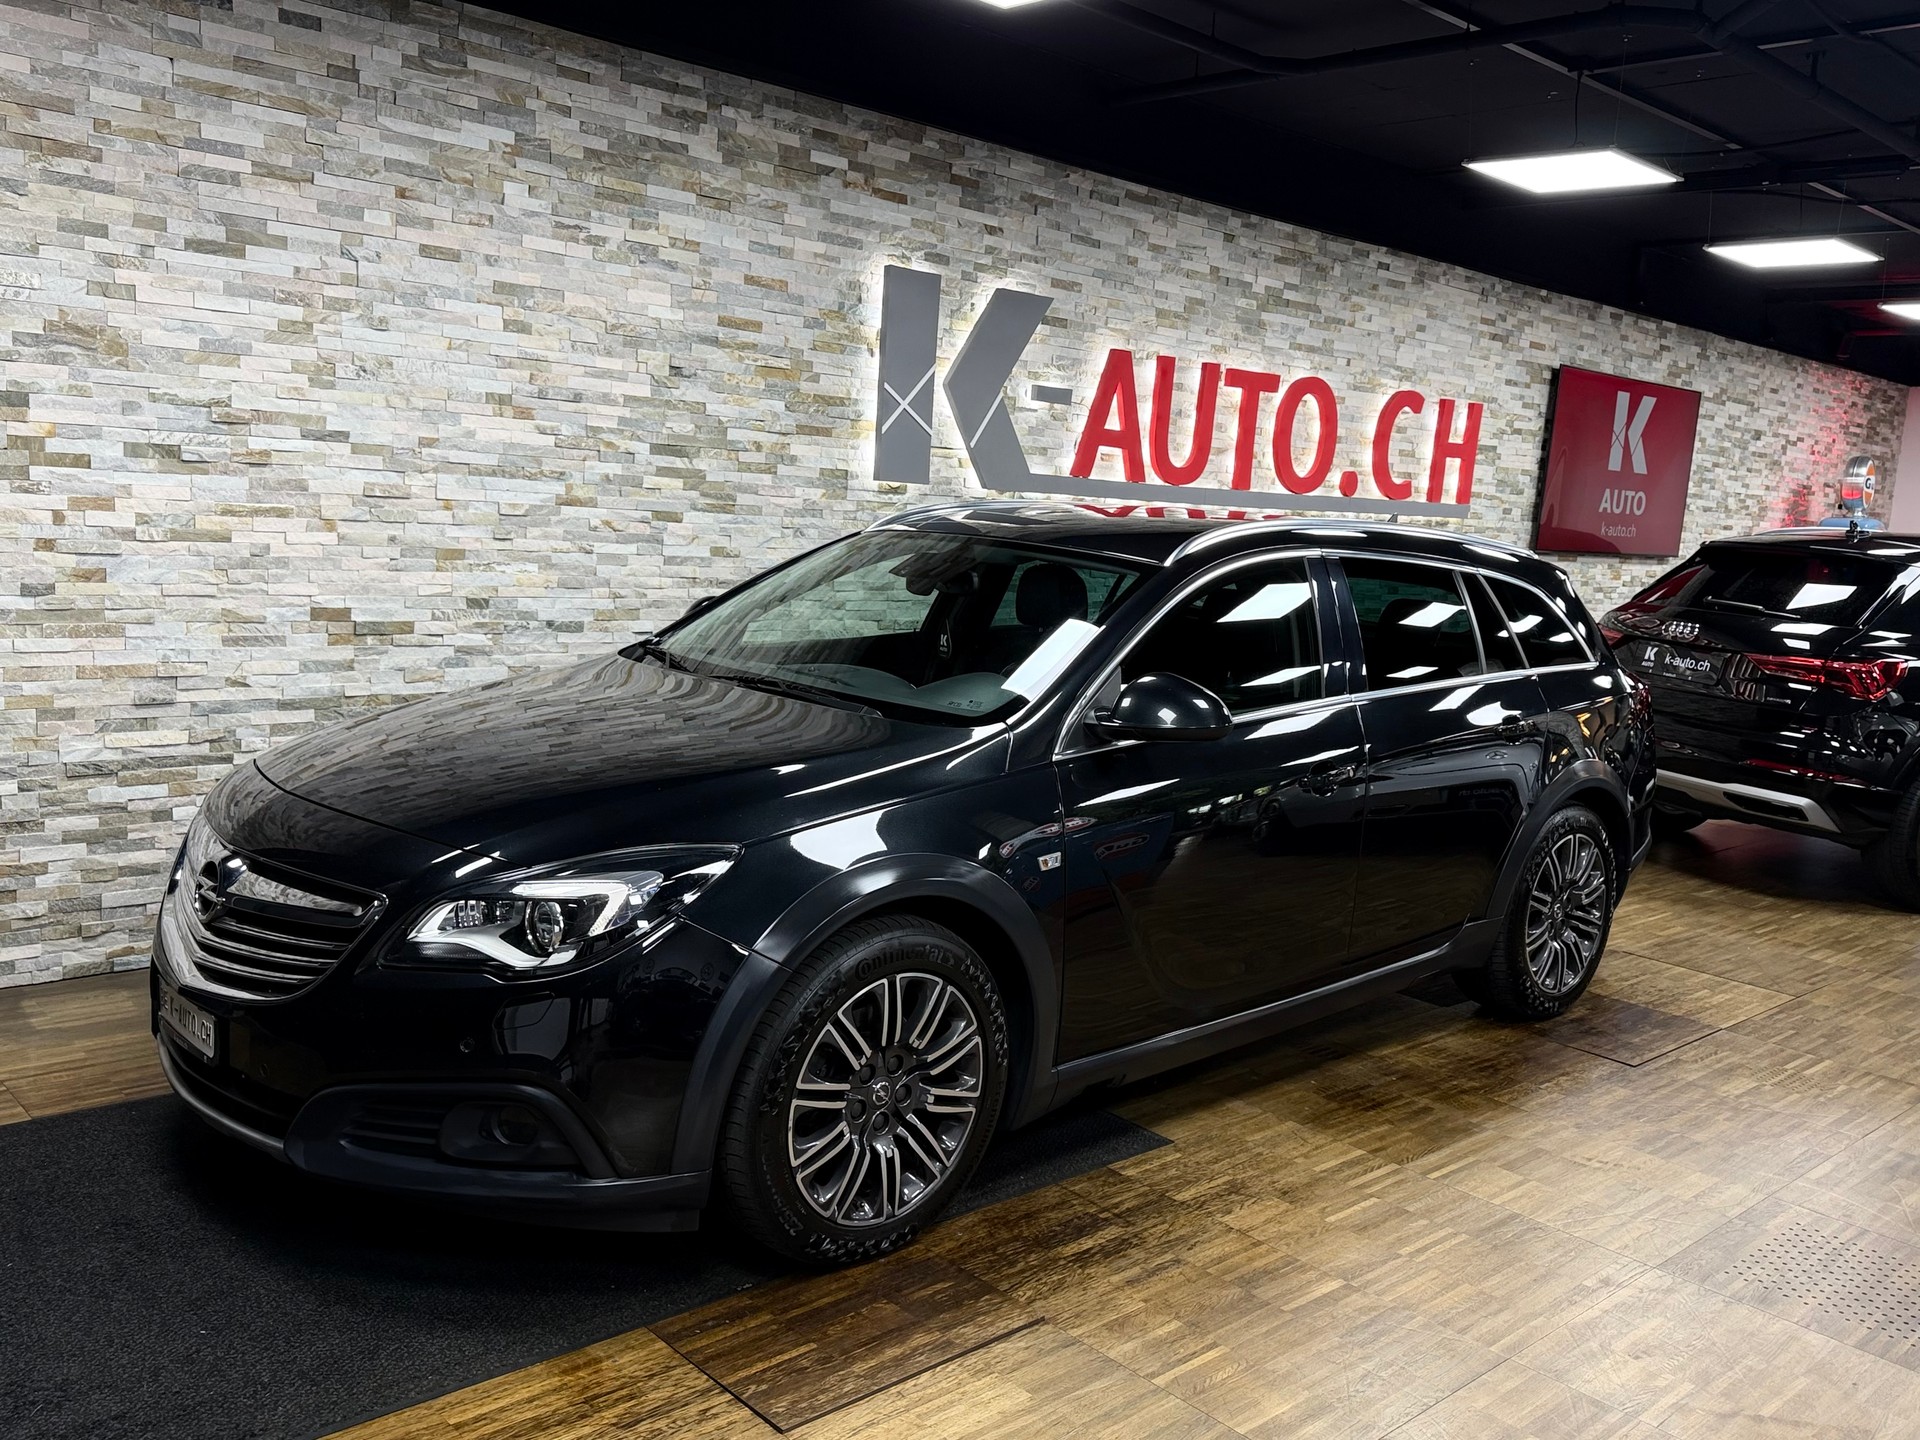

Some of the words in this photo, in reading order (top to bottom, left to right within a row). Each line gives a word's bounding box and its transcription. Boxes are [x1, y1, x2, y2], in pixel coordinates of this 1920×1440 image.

[874, 264, 1484, 505] K-AUTO.CH
[1607, 390, 1657, 475] K
[1599, 488, 1646, 516] AUTO
[1601, 521, 1636, 537] k-auto.ch
[1664, 653, 1711, 672] k-auto.ch
